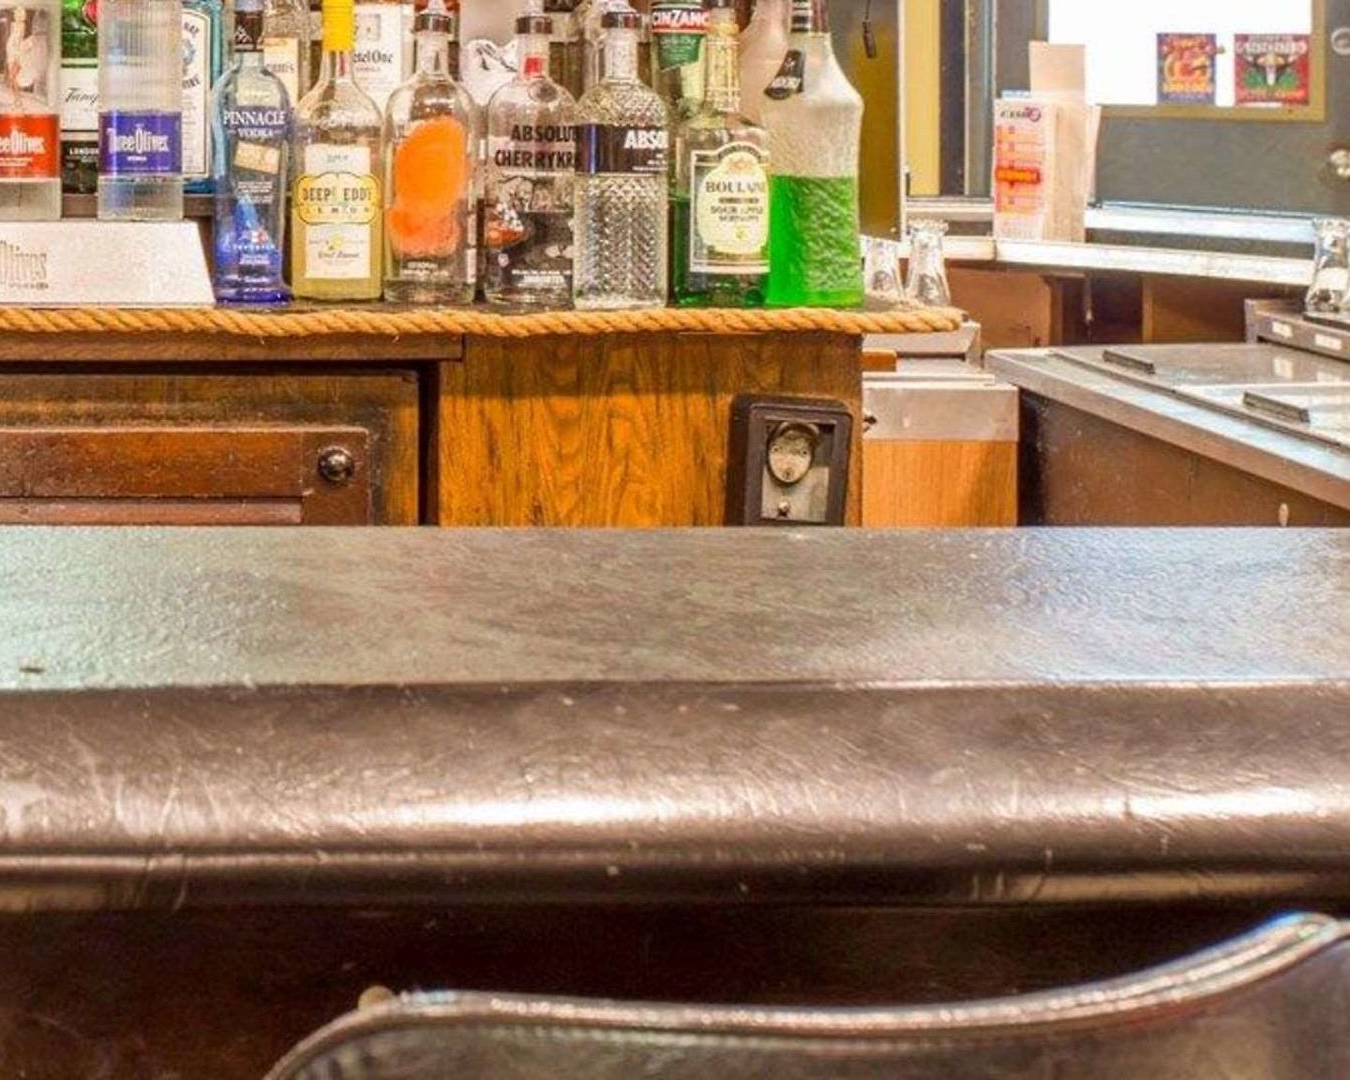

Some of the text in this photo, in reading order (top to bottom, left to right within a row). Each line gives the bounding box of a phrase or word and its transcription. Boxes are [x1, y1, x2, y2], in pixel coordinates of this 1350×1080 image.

[223, 111, 286, 125] PINNACLE
[623, 130, 669, 149] ABSO
[495, 149, 575, 168] CHERRYKR
